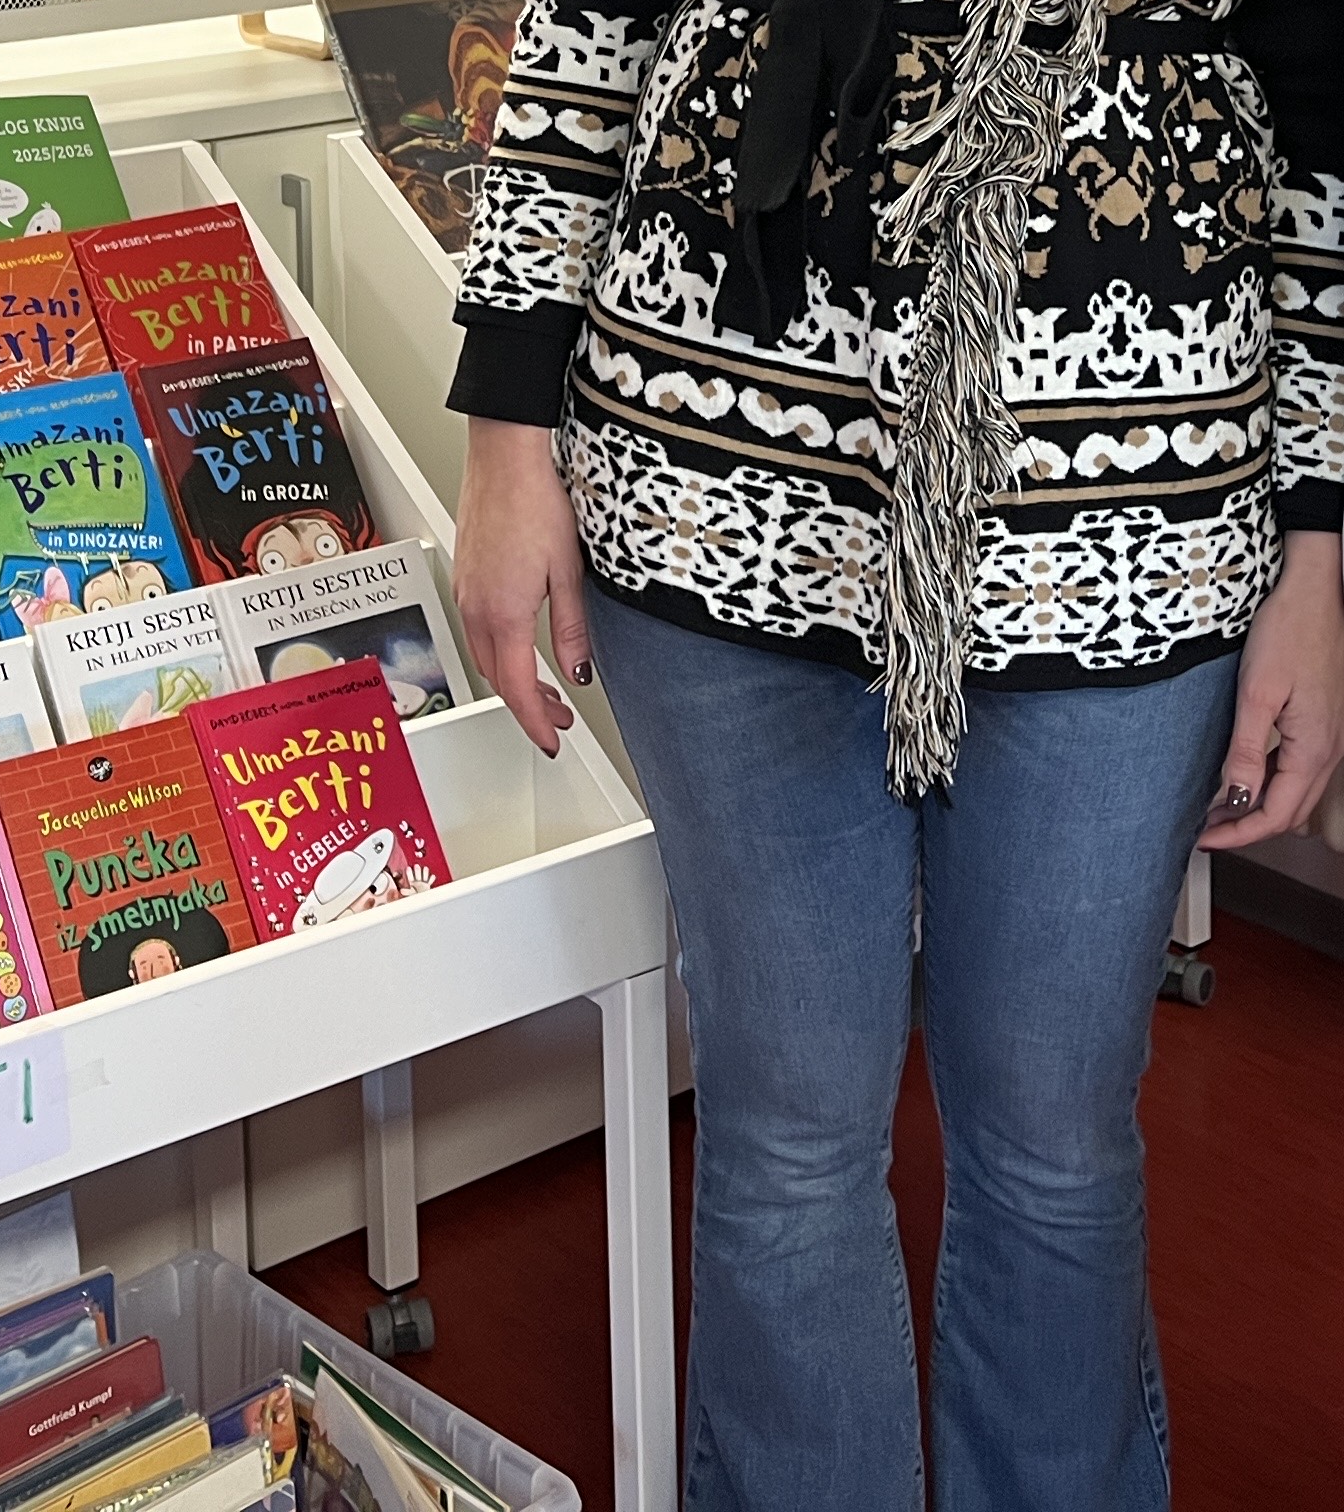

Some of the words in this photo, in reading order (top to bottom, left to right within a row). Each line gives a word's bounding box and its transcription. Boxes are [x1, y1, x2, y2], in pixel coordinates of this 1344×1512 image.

[33, 116, 85, 134] KNJIG
[12, 143, 94, 164] 2025/2026
[103, 255, 253, 303] Umazani
[130, 286, 251, 351] Berti
[188, 333, 205, 356] in
[167, 382, 328, 437] Umazani
[3, 449, 125, 514] Berti
[193, 418, 325, 494] Berti
[241, 484, 257, 502] in
[262, 483, 329, 502] GROZA!
[47, 532, 64, 548] in
[68, 532, 164, 551] DINOZAVER!
[242, 584, 305, 615] KRTJI
[315, 557, 410, 596] SESTRICI
[267, 615, 286, 632] IN
[291, 598, 362, 627] MESEČNA
[365, 587, 400, 607] NOČ
[66, 620, 135, 653] KRTJI
[143, 602, 214, 635] SESTR
[86, 655, 105, 672] IN
[111, 639, 178, 667] HLADEN
[221, 717, 387, 786] Umazani
[38, 796, 129, 836] Jacqueline
[127, 782, 183, 810] Wilson
[237, 760, 373, 852] Berti
[43, 828, 202, 910] Punčka
[273, 870, 295, 889] in
[289, 819, 359, 874] ČEBELE!
[55, 921, 84, 953] iz
[86, 876, 229, 953] smetnjaka
[28, 1404, 77, 1438] Gottfried
[77, 1386, 114, 1413] Kumpf
